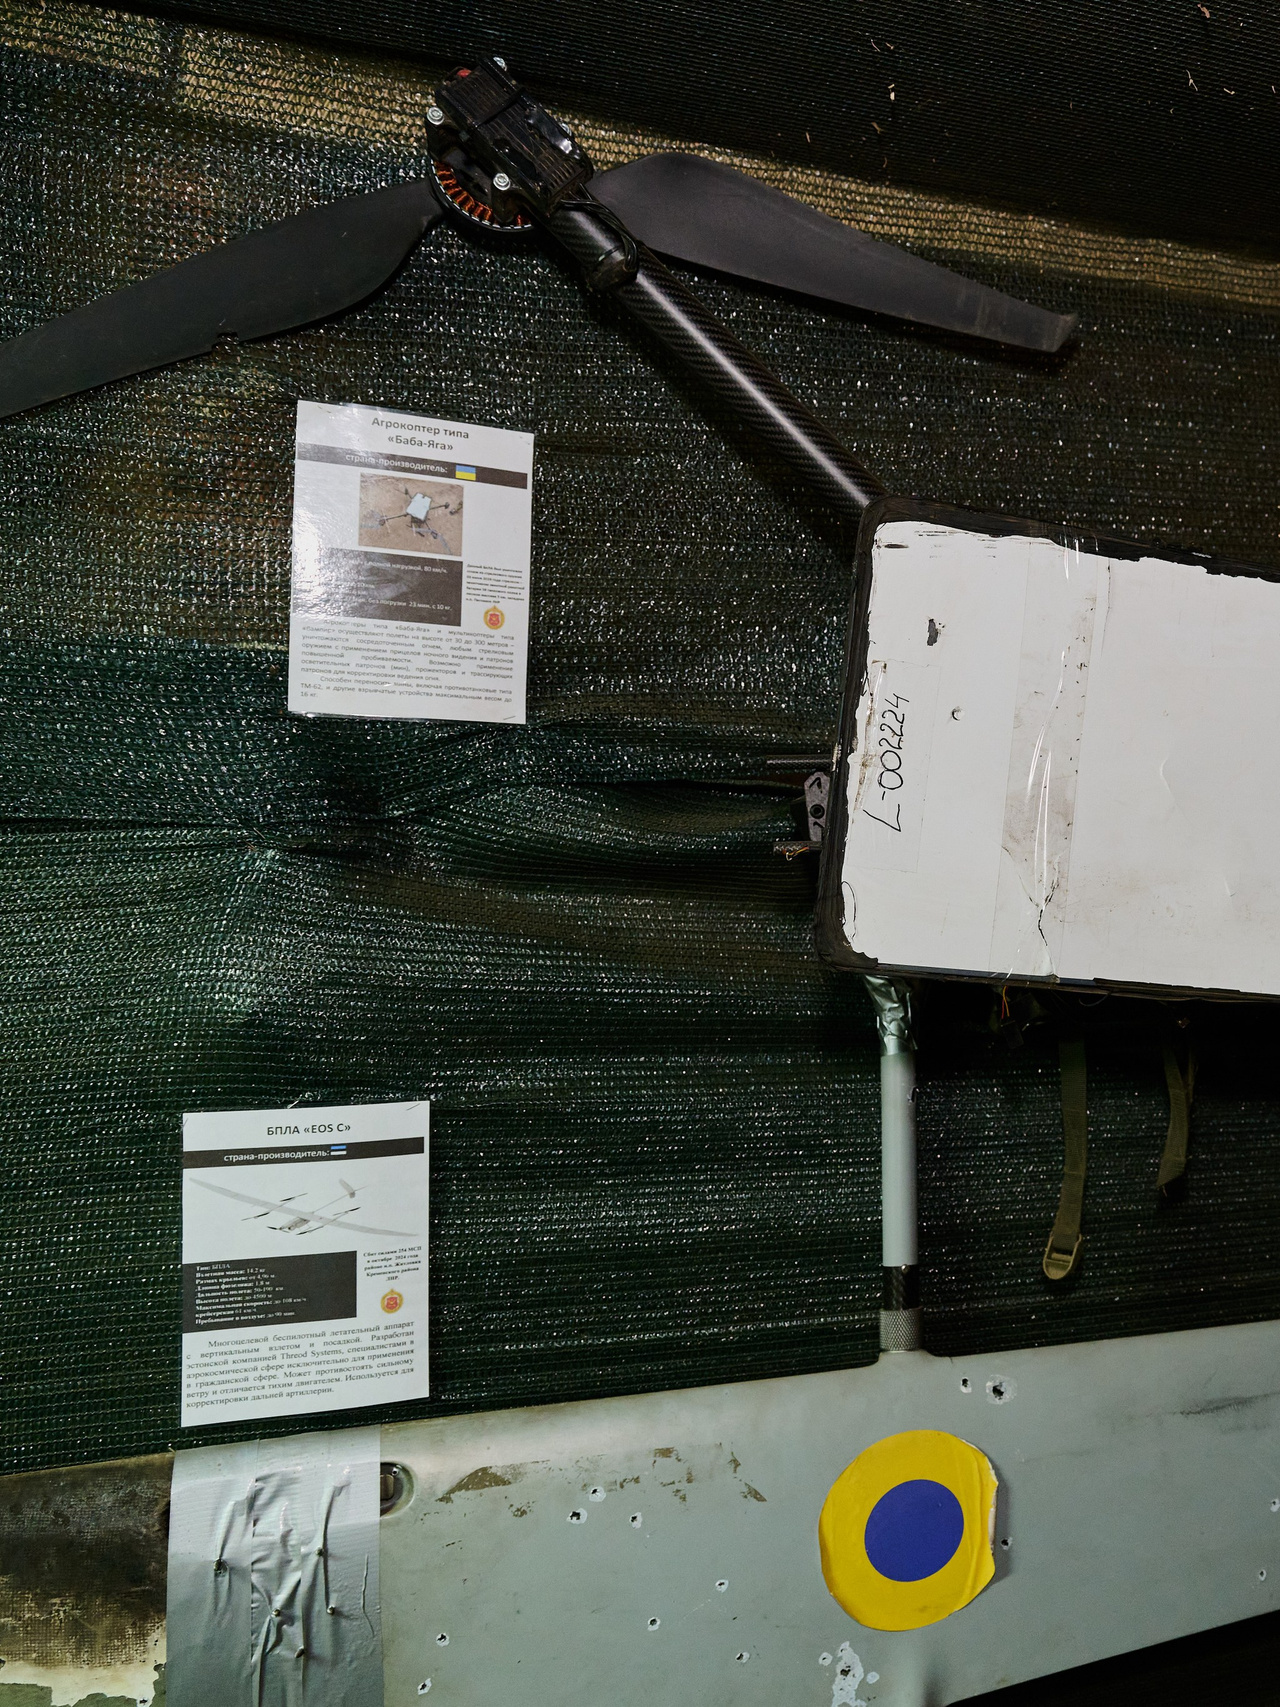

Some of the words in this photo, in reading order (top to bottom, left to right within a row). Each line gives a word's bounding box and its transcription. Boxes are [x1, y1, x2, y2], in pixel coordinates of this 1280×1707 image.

[372, 417, 440, 437] Агрокоптер
[444, 429, 470, 439] типа
[388, 435, 454, 451] «Баба-Яга»
[346, 454, 448, 474] страна-производитель:
[357, 639, 415, 647] сосредоточенным
[449, 631, 495, 639] мультикоптеры
[361, 655, 413, 663] пробиваемости.
[863, 693, 910, 833] L-002224
[267, 1126, 300, 1136] БПЛА
[304, 1124, 334, 1133] «EOS
[337, 1123, 351, 1132] C»
[224, 1150, 330, 1163] страна-производитель:
[201, 1348, 259, 1359] вертикальным
[323, 1336, 362, 1346] посадкой.
[371, 1331, 414, 1340] Разработан
[208, 1336, 268, 1348] Многоцелевой
[273, 1330, 326, 1341] беспилотный
[330, 1324, 380, 1336] летательный
[384, 1322, 414, 1330] аппарат
[186, 1359, 228, 1369] эстонской
[232, 1354, 276, 1364] компанией
[281, 1351, 307, 1360] Threod
[311, 1349, 344, 1358] Systems,
[348, 1341, 407, 1352] специалистами
[186, 1366, 258, 1379] аэрокосмической
[261, 1364, 284, 1372] сфере
[287, 1358, 349, 1368] исключительно
[368, 1349, 414, 1360] применения
[196, 1376, 249, 1388] гражданской
[253, 1374, 279, 1382] сфере.
[316, 1364, 373, 1376] противостоять
[377, 1359, 414, 1368] сильному
[220, 1385, 265, 1394] отличается
[295, 1377, 343, 1387] двигателем.
[345, 1370, 398, 1381] Используется
[186, 1397, 248, 1408] корректировки
[251, 1391, 283, 1401] дальней
[286, 1387, 334, 1398] артиллерии.
